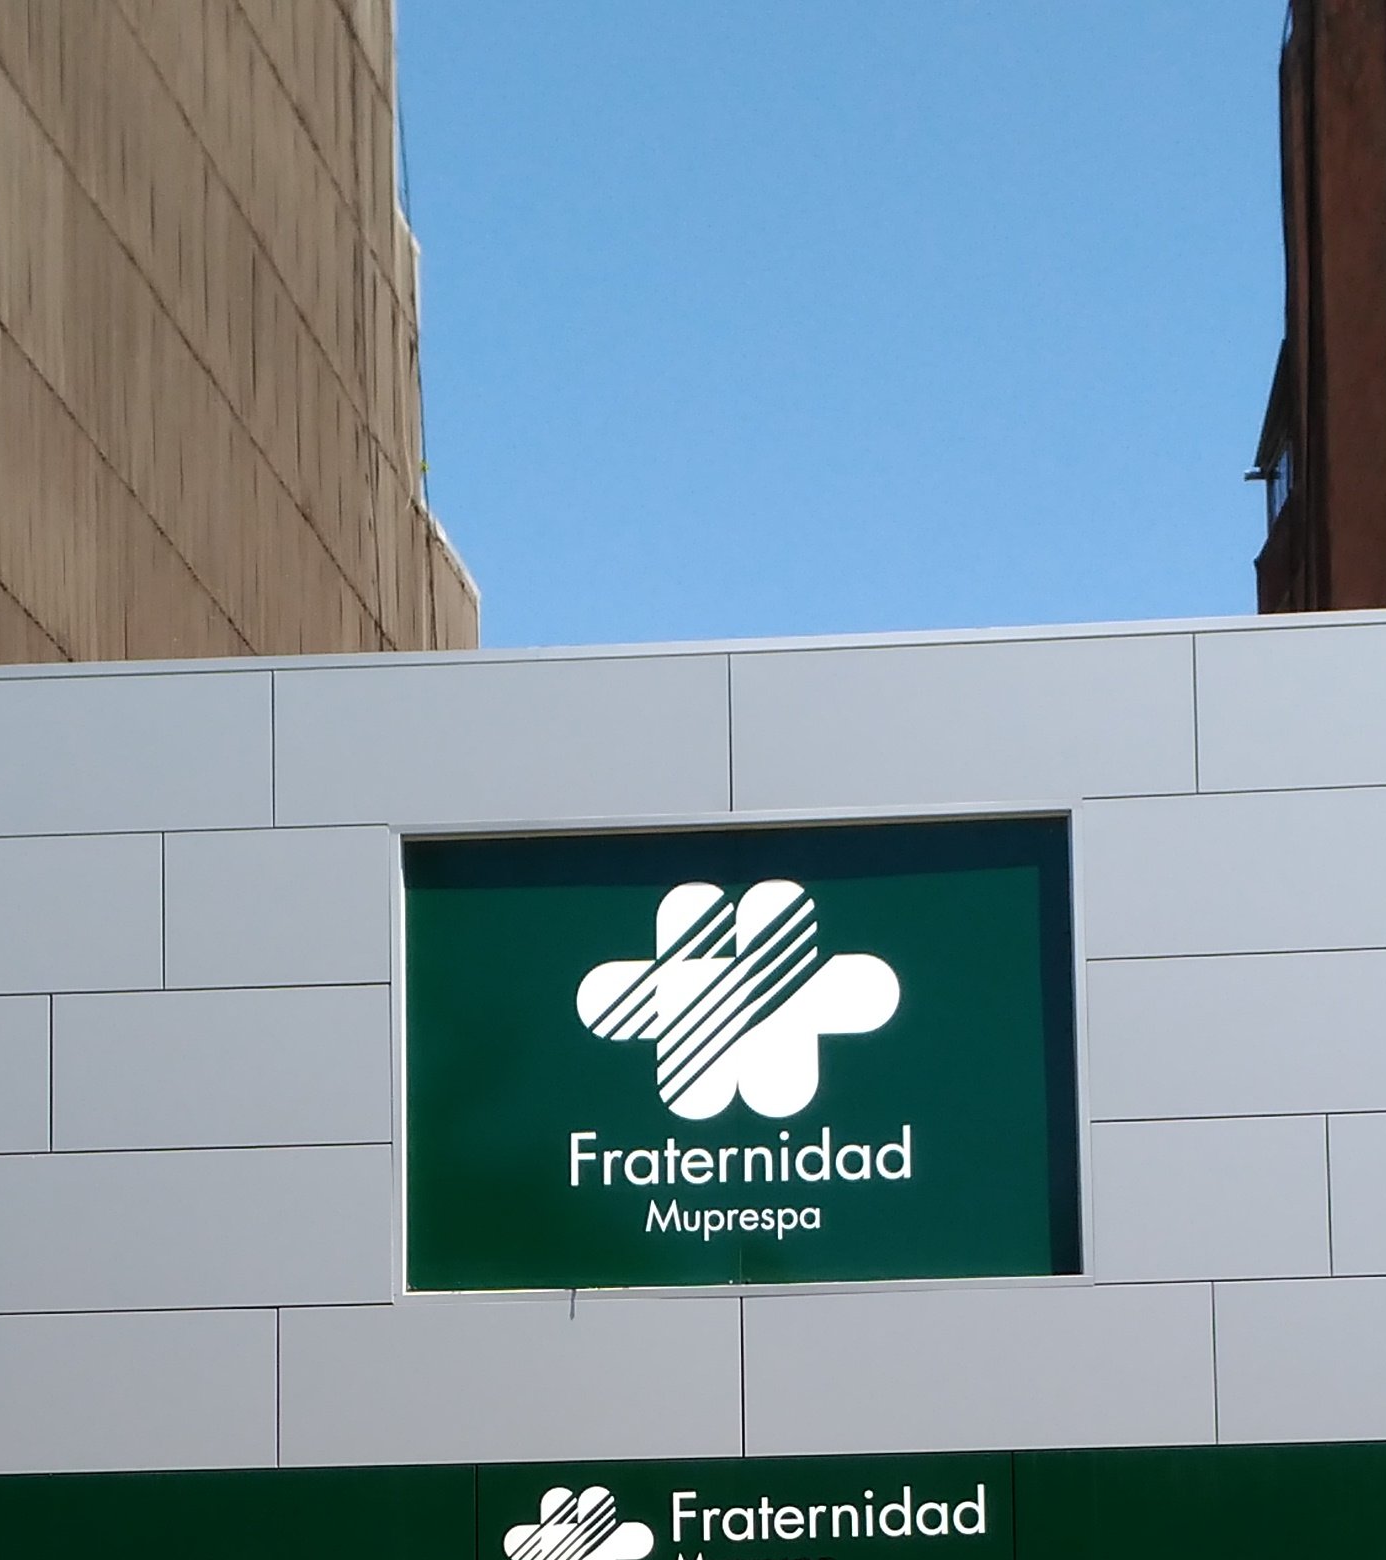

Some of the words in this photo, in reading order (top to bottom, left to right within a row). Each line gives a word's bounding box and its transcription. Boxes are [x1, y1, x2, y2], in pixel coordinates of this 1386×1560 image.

[569, 1124, 912, 1187] Fraternidad
[645, 1200, 821, 1241] Muprespa
[672, 1484, 986, 1542] Fraternidad
